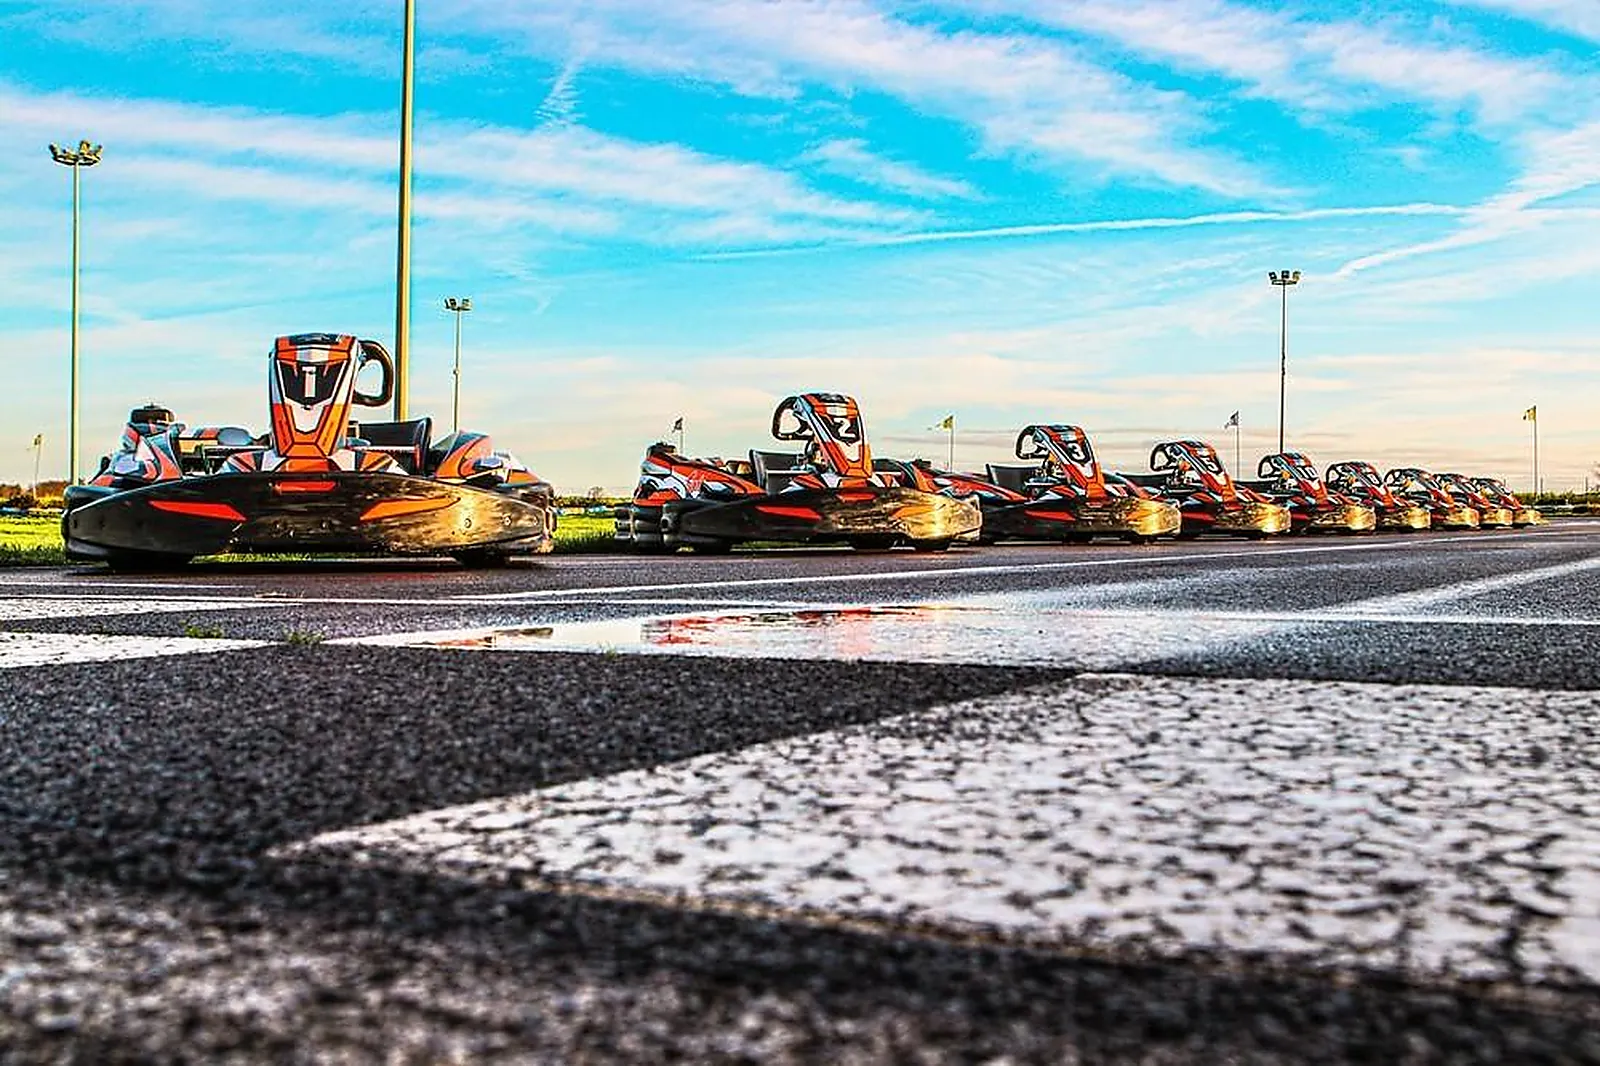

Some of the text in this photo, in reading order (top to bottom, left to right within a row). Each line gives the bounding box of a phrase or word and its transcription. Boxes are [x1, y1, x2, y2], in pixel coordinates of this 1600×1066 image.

[301, 366, 317, 398] 1
[833, 417, 856, 438] 2
[1067, 442, 1086, 461] 3
[1200, 457, 1219, 473] 5
